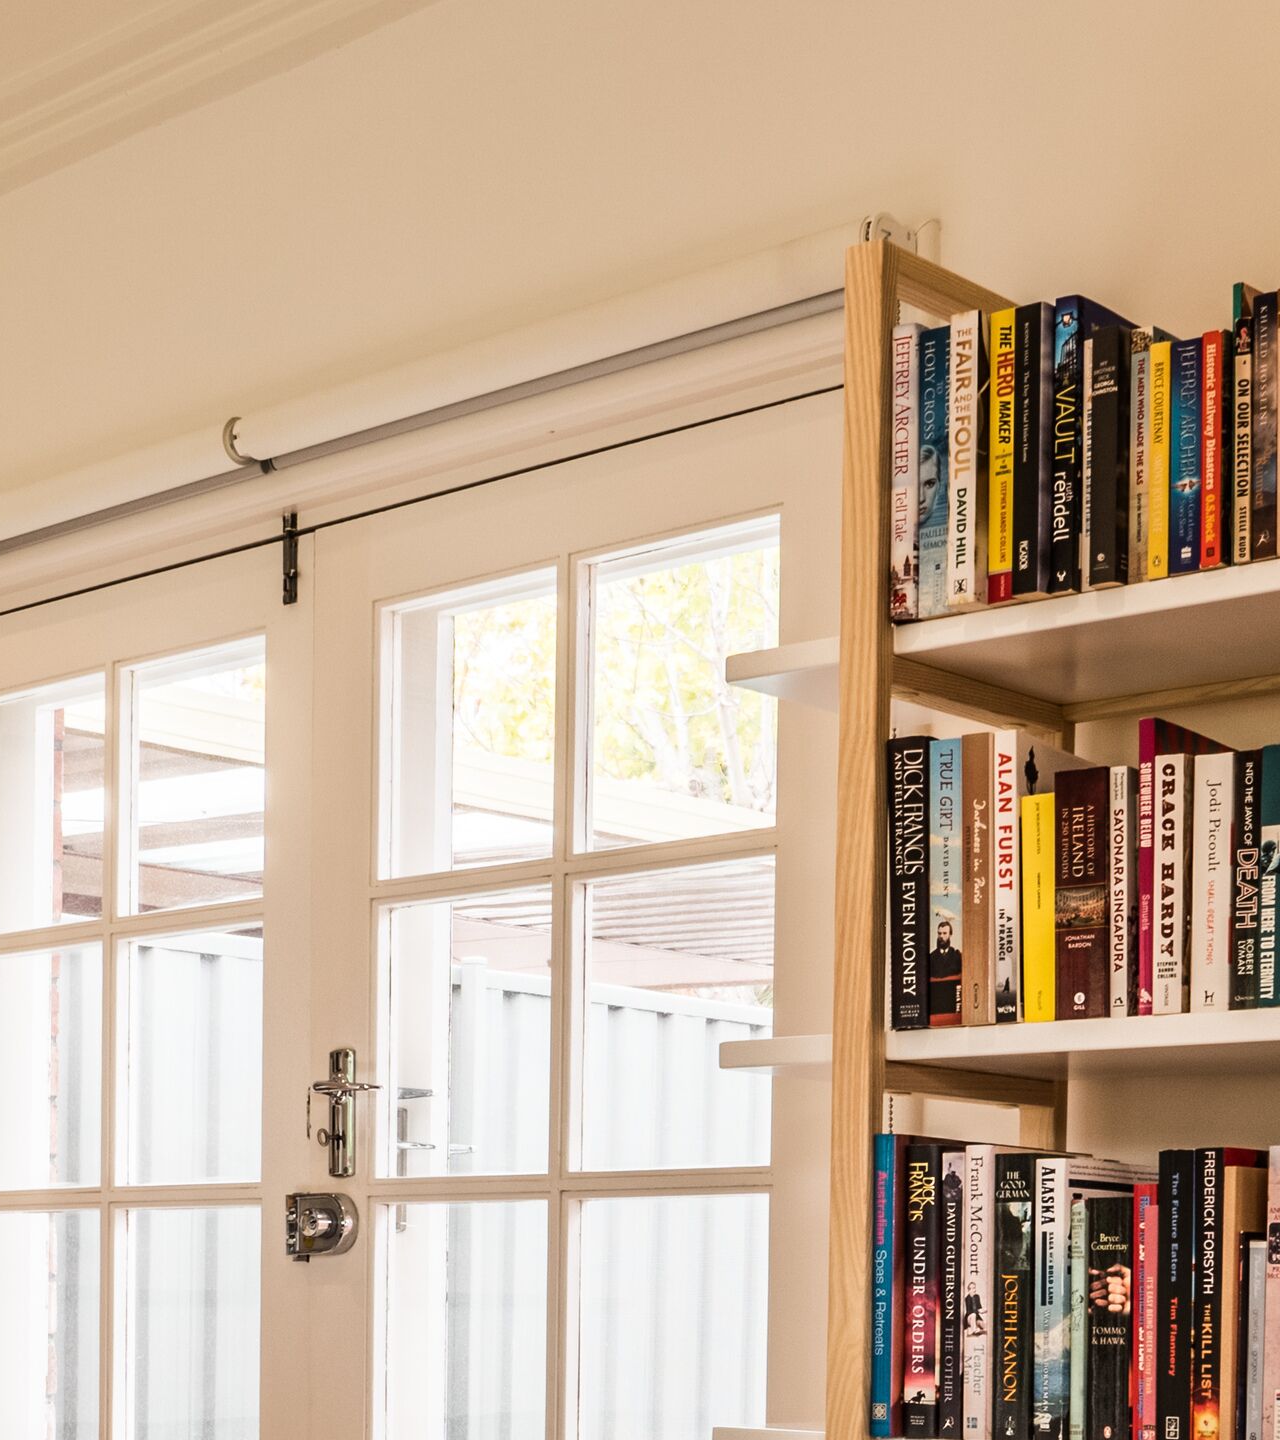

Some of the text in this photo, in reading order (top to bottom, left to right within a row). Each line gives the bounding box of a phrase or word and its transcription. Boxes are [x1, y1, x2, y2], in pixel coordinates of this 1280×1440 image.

[956, 339, 972, 393] FAIR
[996, 350, 1014, 398] HERO
[999, 325, 1012, 349] THE
[894, 335, 912, 477] JEFFREY ARCHER
[998, 401, 1011, 444] MAKER
[1055, 385, 1075, 463] VAULT
[1137, 399, 1145, 420] WHO
[1204, 344, 1216, 490] Historic Railway Disasters
[1237, 379, 1249, 497] ON OUR SELECTION
[954, 415, 971, 480] FOUL
[955, 487, 967, 569] DAVID HILL
[1053, 472, 1070, 543] rendell
[1066, 482, 1074, 502] ruth
[1238, 506, 1247, 558] STEELE RUDD
[903, 749, 924, 874] DICK FRANCIS
[940, 750, 953, 831] TRUE GIRT
[998, 753, 1012, 890] ALAN FURST
[1140, 762, 1151, 848] SOMEWHERE BELOW
[1206, 780, 1222, 872] Jodi Picoult
[1072, 807, 1084, 877] IRELAND
[1161, 764, 1174, 957] CRACK HARDY
[902, 882, 915, 924] EVEN
[999, 909, 1006, 919] IN
[1114, 809, 1124, 972] SAYONARA SINGAPURA
[1142, 894, 1150, 931] Samuels
[1236, 848, 1258, 928] DEATH
[902, 932, 916, 996] MONEY
[1238, 940, 1246, 975] LYMAN
[1246, 939, 1254, 975] ROBERT
[1260, 875, 1276, 999] FROM HERE TO ETERNITY
[969, 1156, 983, 1275] Frank McCourt
[1041, 1166, 1056, 1226] ALASKA
[1170, 1173, 1179, 1282] The Future Eaters
[1203, 1151, 1215, 1294] FREDERICK FORSYTH
[1090, 1242, 1128, 1251] Courtenay
[911, 1237, 925, 1374] UNDER ORDERS
[1001, 1274, 1018, 1402] JOSEPH KANON
[1092, 1326, 1126, 1334] TOMMO
[1168, 1298, 1178, 1375] Tim Flannery
